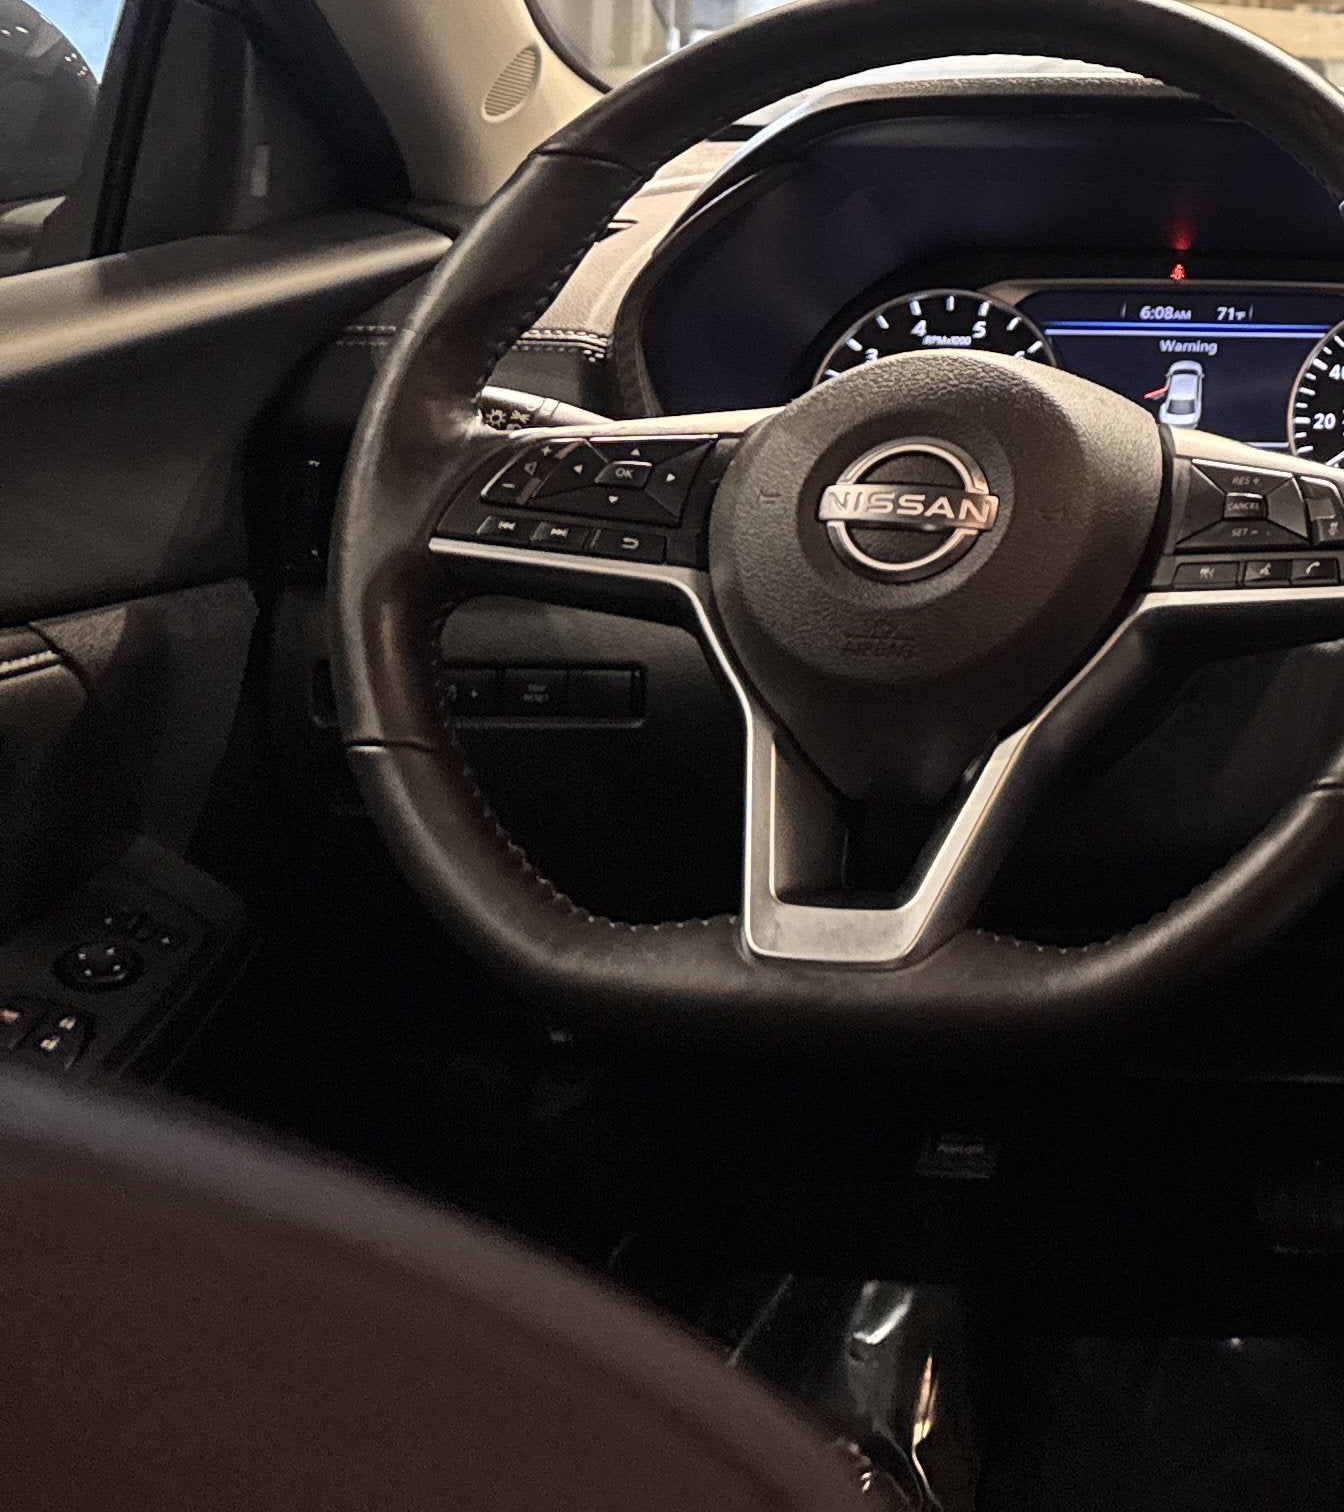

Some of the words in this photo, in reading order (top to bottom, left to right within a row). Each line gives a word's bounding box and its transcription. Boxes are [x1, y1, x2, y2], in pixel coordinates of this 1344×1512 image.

[911, 320, 927, 337] 4
[972, 321, 987, 338] 5
[865, 347, 879, 362] 3
[1159, 339, 1218, 356] Warning
[1312, 412, 1337, 430] 20
[615, 467, 634, 480] OK
[827, 490, 991, 524] NISSAN
